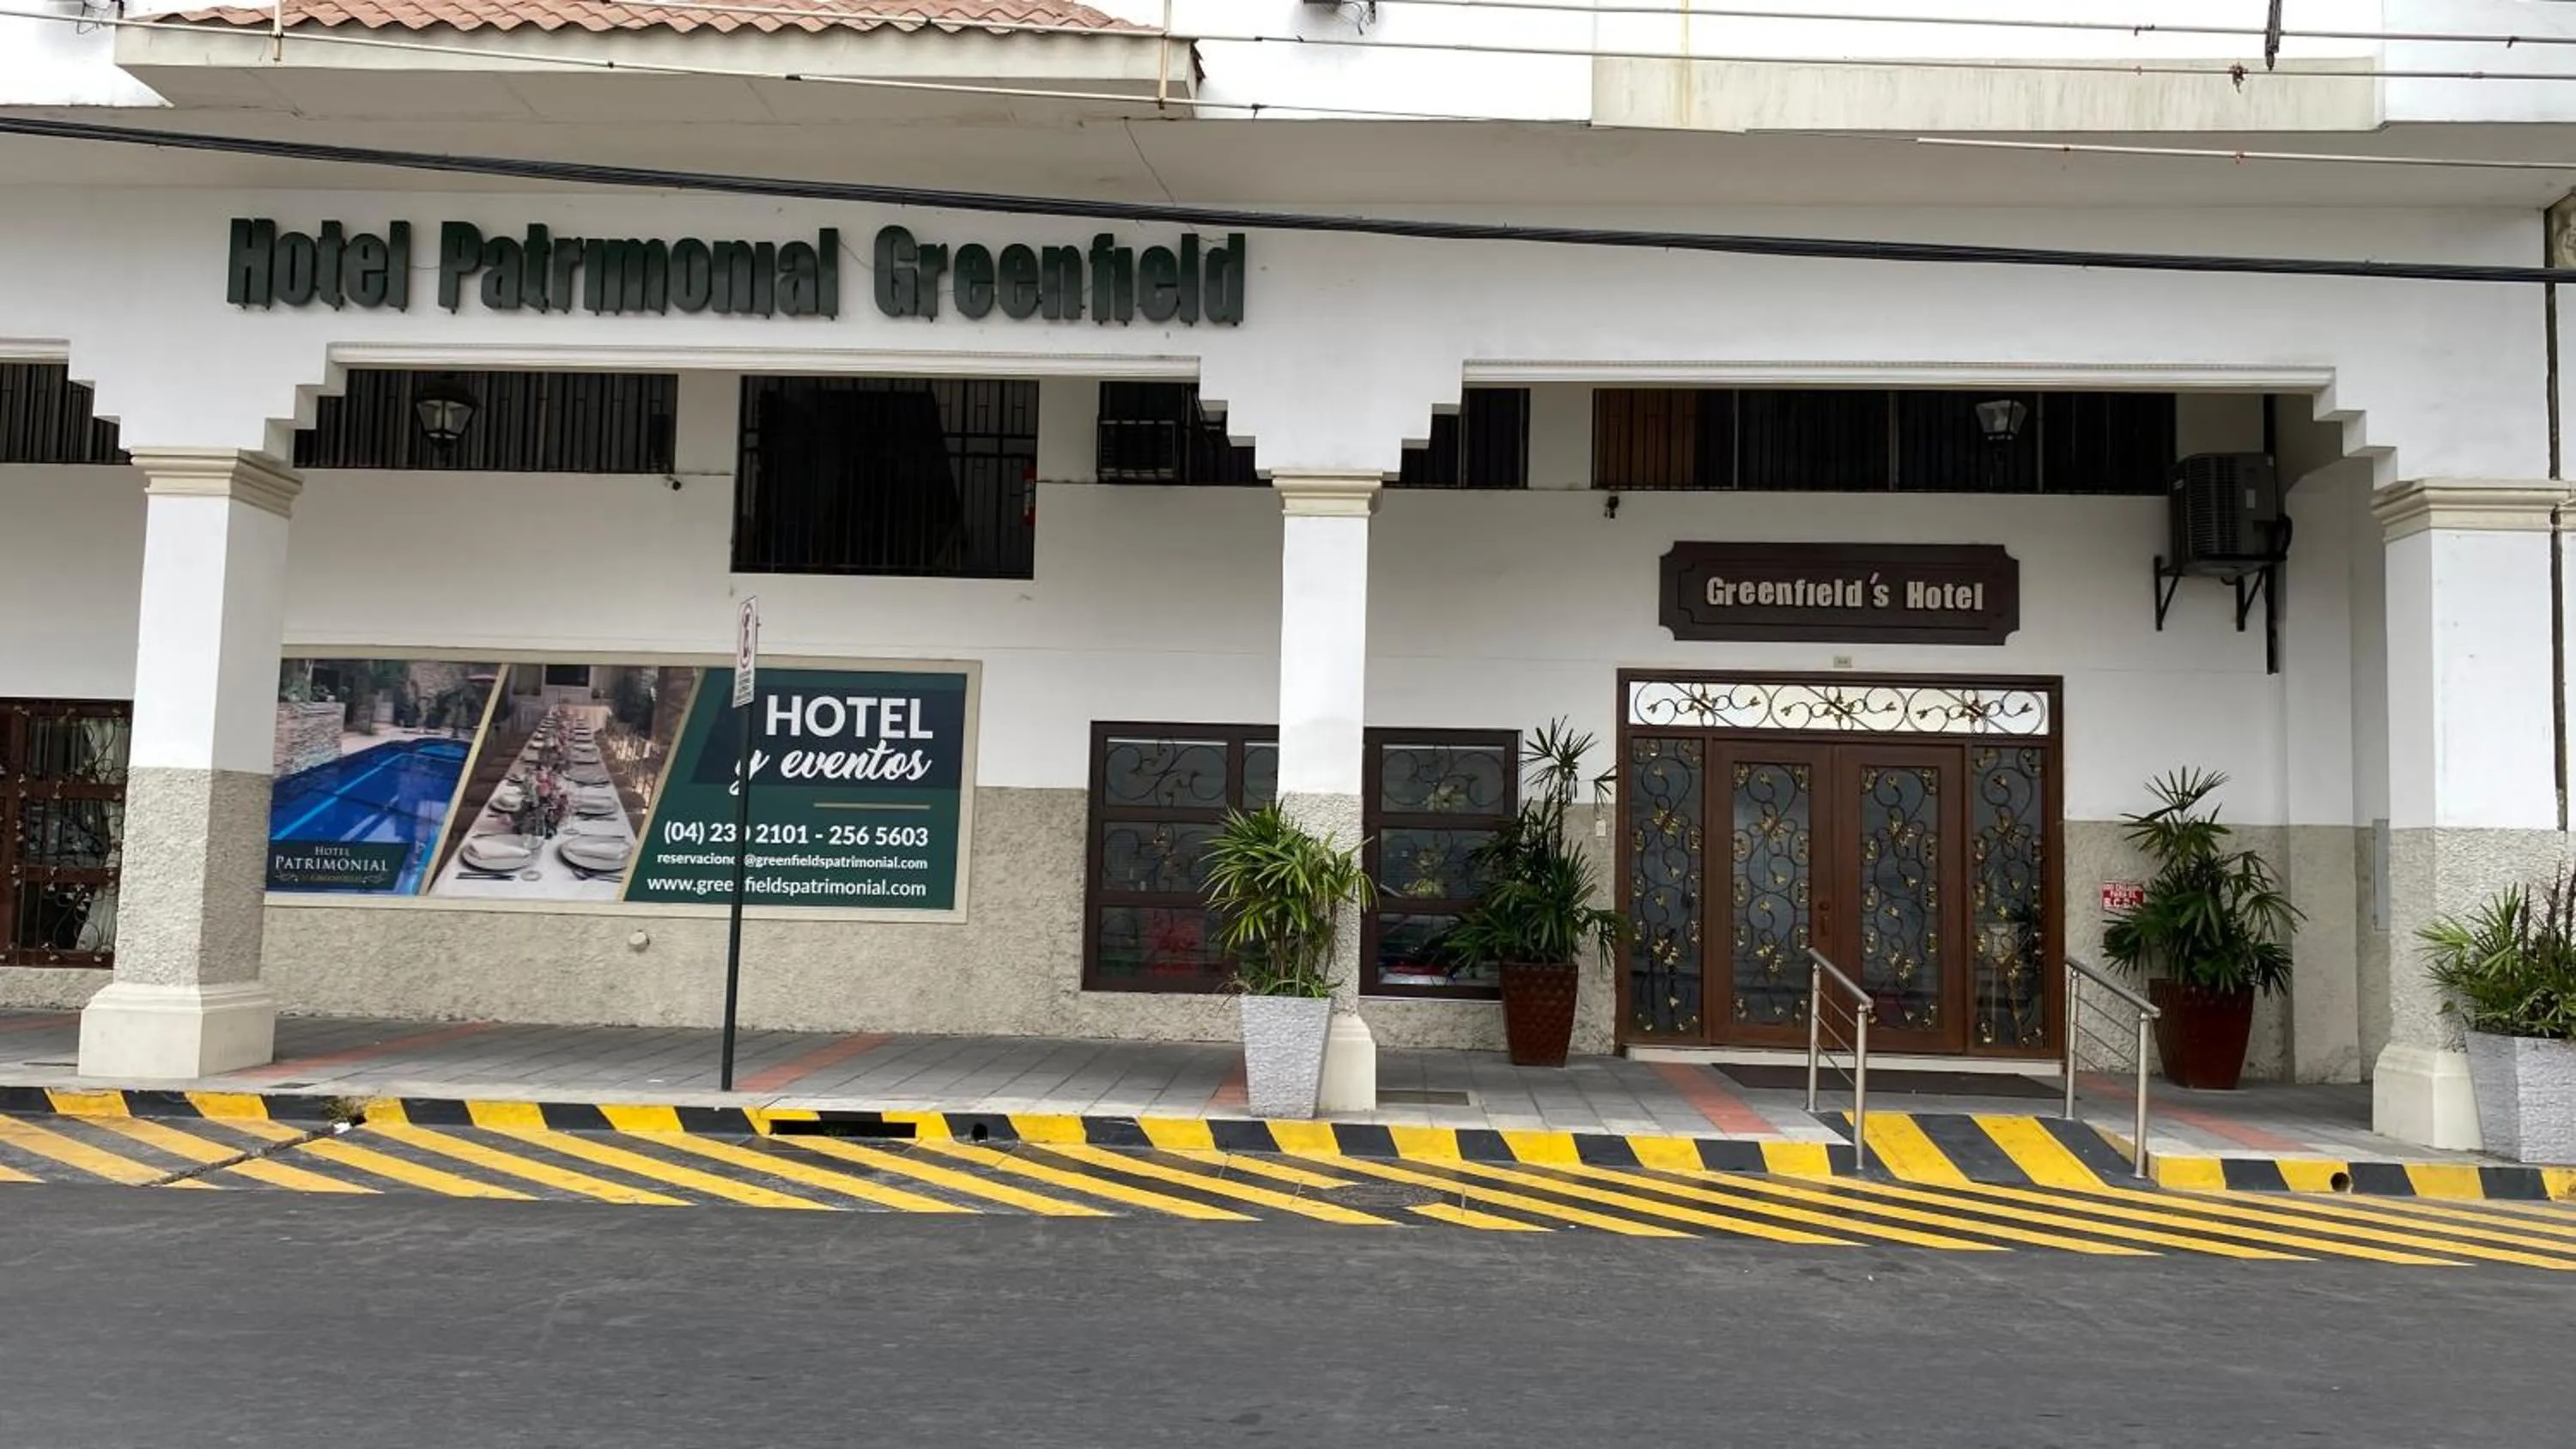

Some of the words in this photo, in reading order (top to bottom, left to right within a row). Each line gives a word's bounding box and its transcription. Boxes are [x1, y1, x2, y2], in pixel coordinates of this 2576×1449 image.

[227, 217, 410, 311] Hotel
[438, 221, 838, 318] Patrimonial
[873, 225, 1245, 324] Greenfield
[1906, 581, 1984, 610] Hotel
[766, 694, 933, 739] HOTEL
[781, 739, 932, 780] eventos
[664, 822, 704, 845] (04)
[756, 824, 809, 844] 2101
[829, 826, 869, 846] 256
[875, 827, 928, 846] 5603
[275, 855, 388, 871] PATRIMONIAL
[657, 852, 927, 870] reservacion@greenfieldspatrimonial.com
[647, 876, 927, 896] www.greefieldspatrimonial.com
